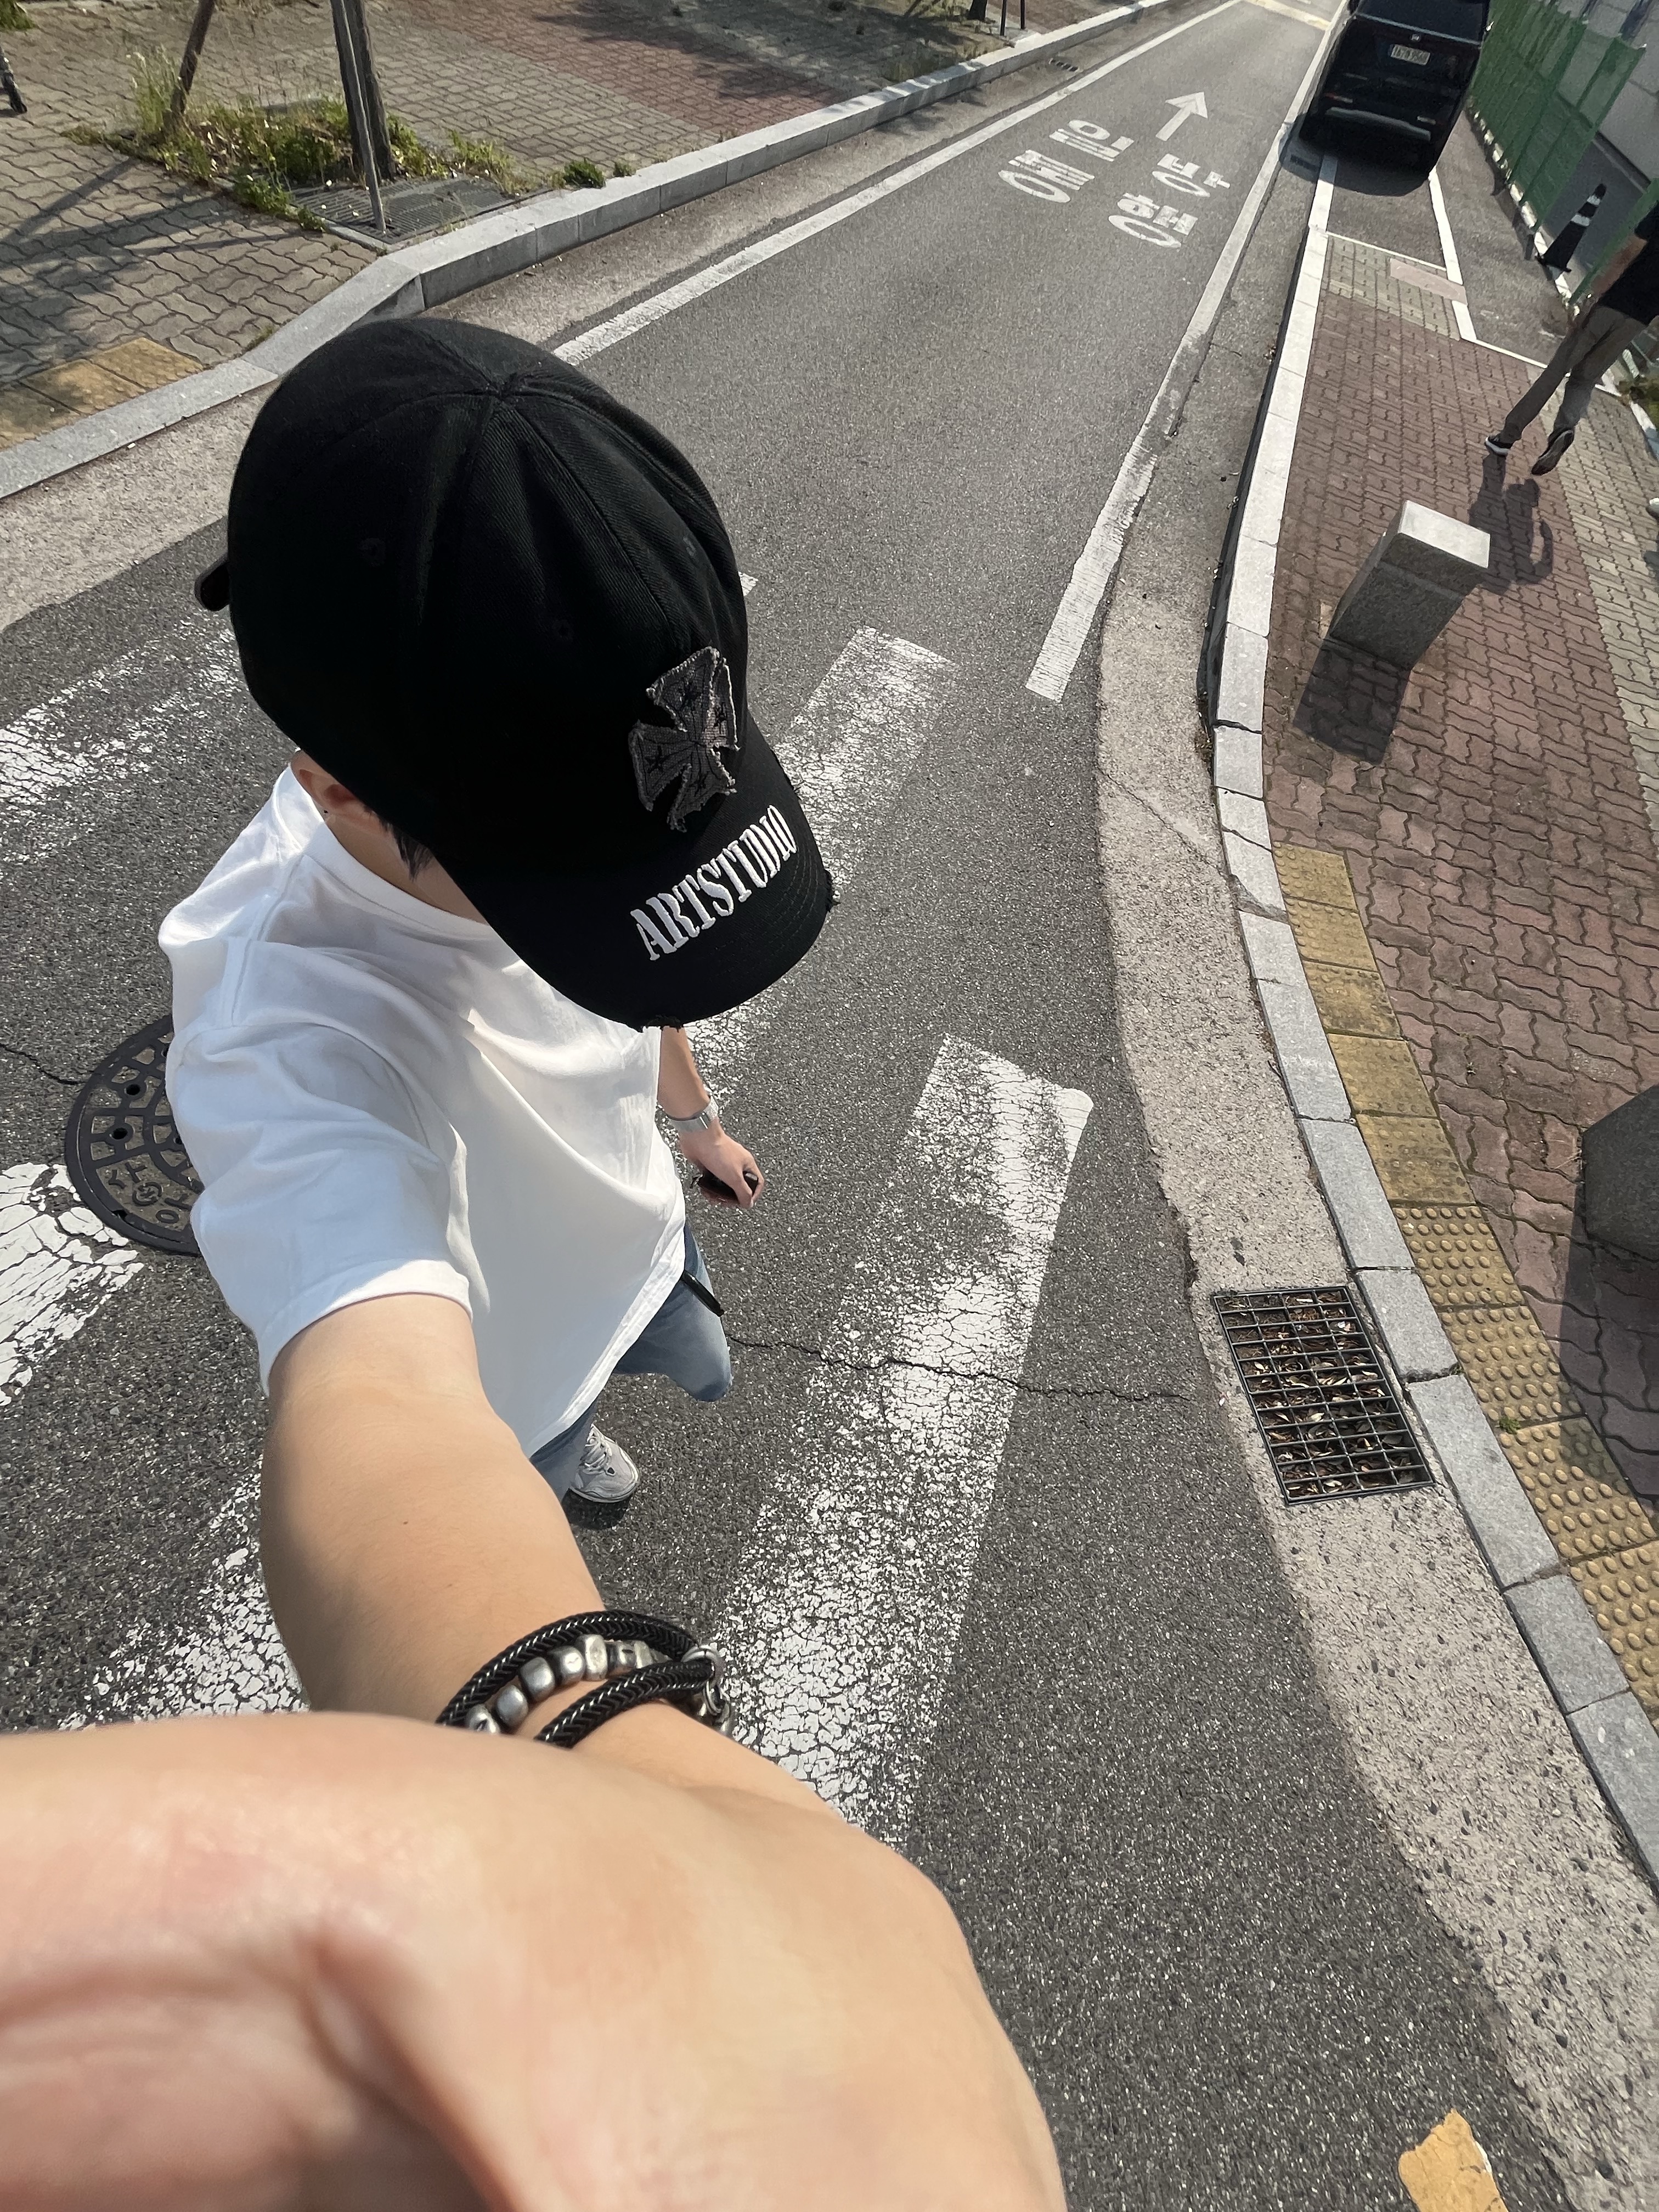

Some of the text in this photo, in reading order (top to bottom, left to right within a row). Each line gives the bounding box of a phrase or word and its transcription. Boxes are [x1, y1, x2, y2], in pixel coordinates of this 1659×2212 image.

[997, 149, 1198, 249] 통행
[1048, 119, 1231, 198] 일방
[630, 805, 797, 961] ARTSTUDIO
